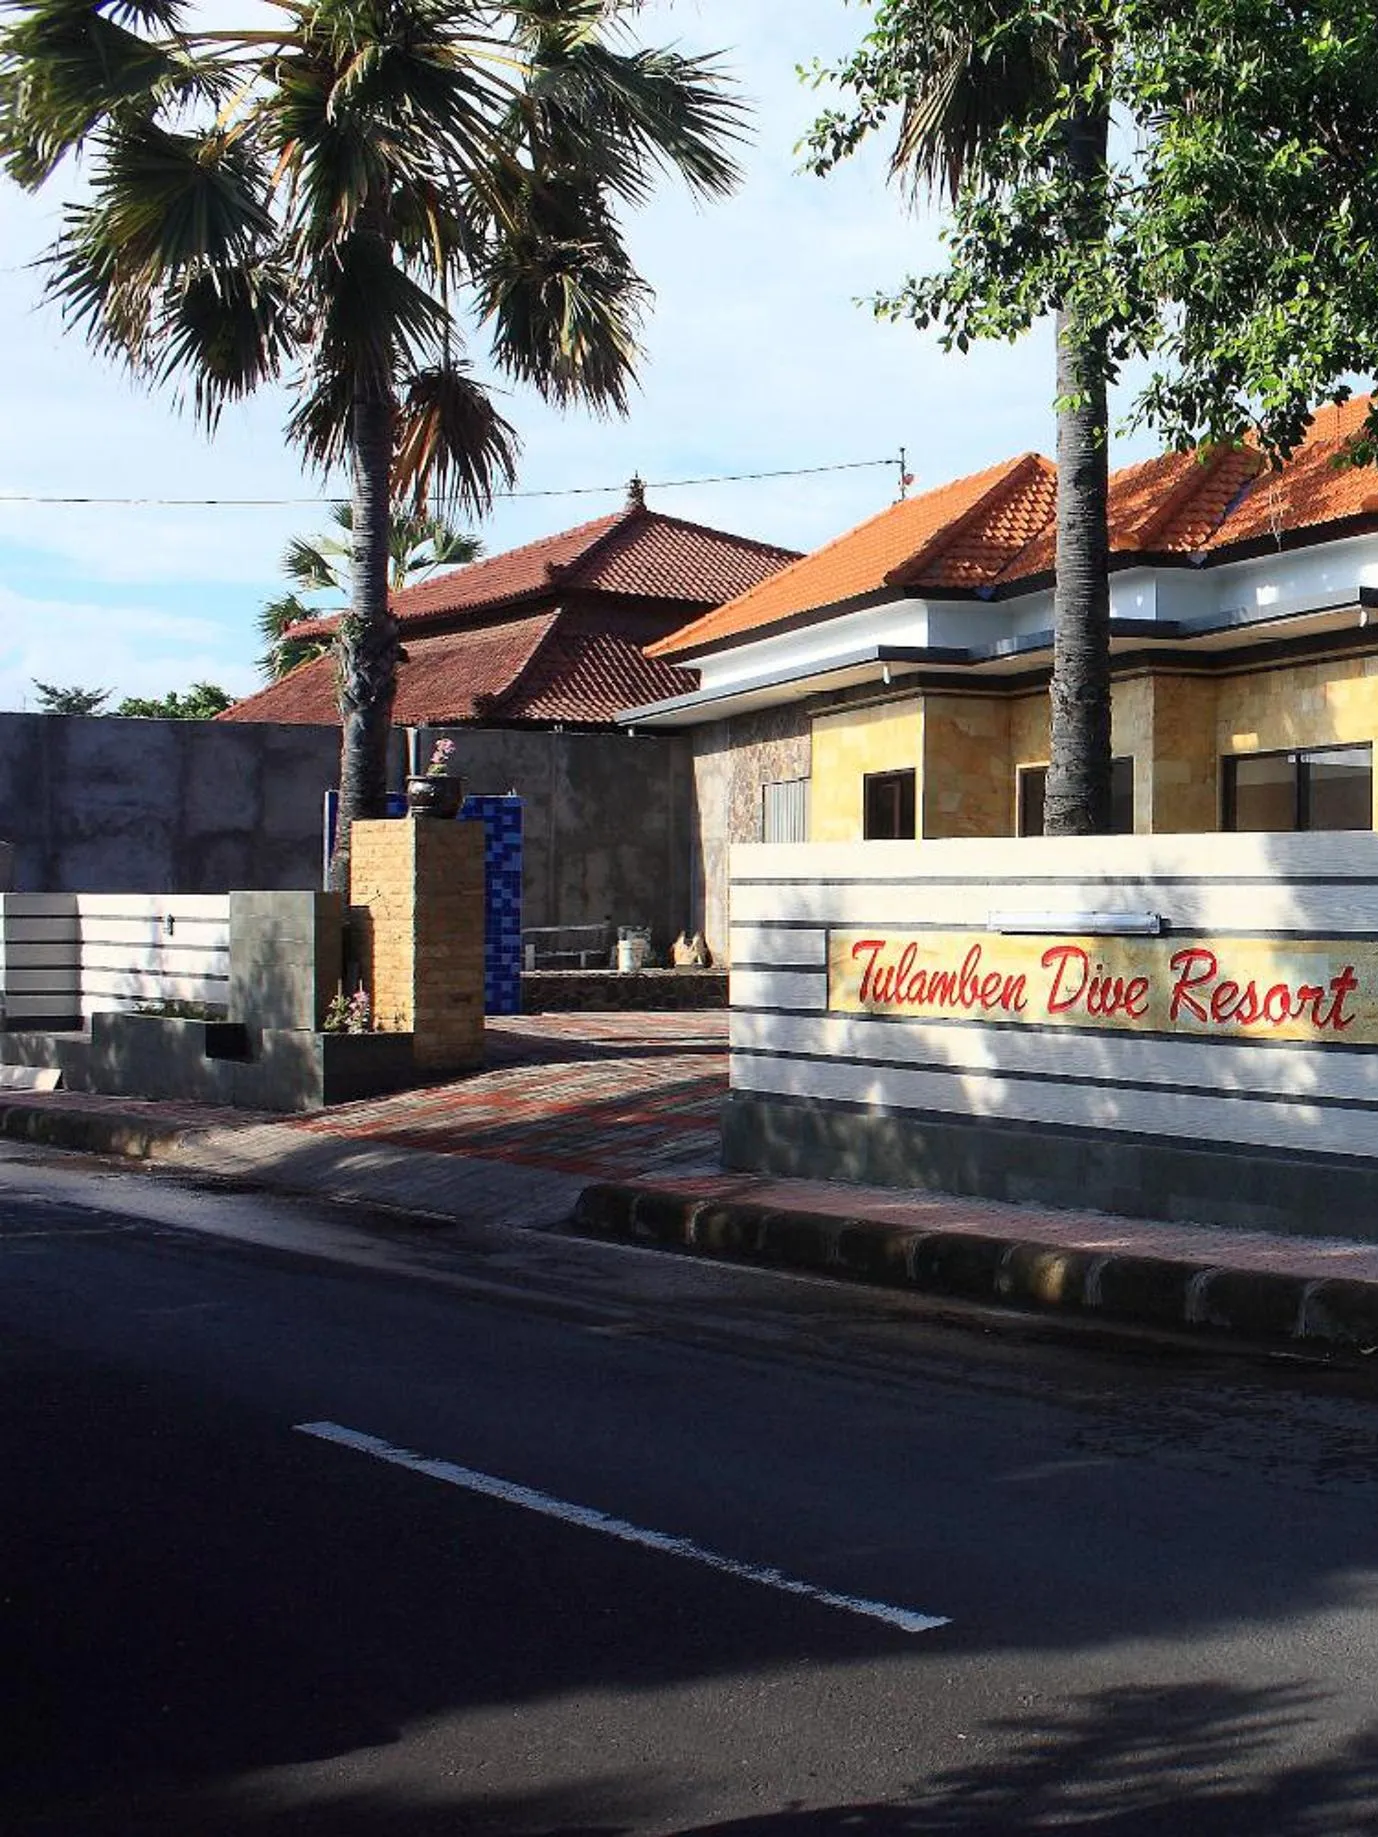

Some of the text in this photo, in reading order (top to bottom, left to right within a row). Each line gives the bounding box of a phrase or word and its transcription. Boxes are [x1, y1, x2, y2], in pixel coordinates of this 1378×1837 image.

[851, 939, 1356, 1032] Tulamben Dive Resort
